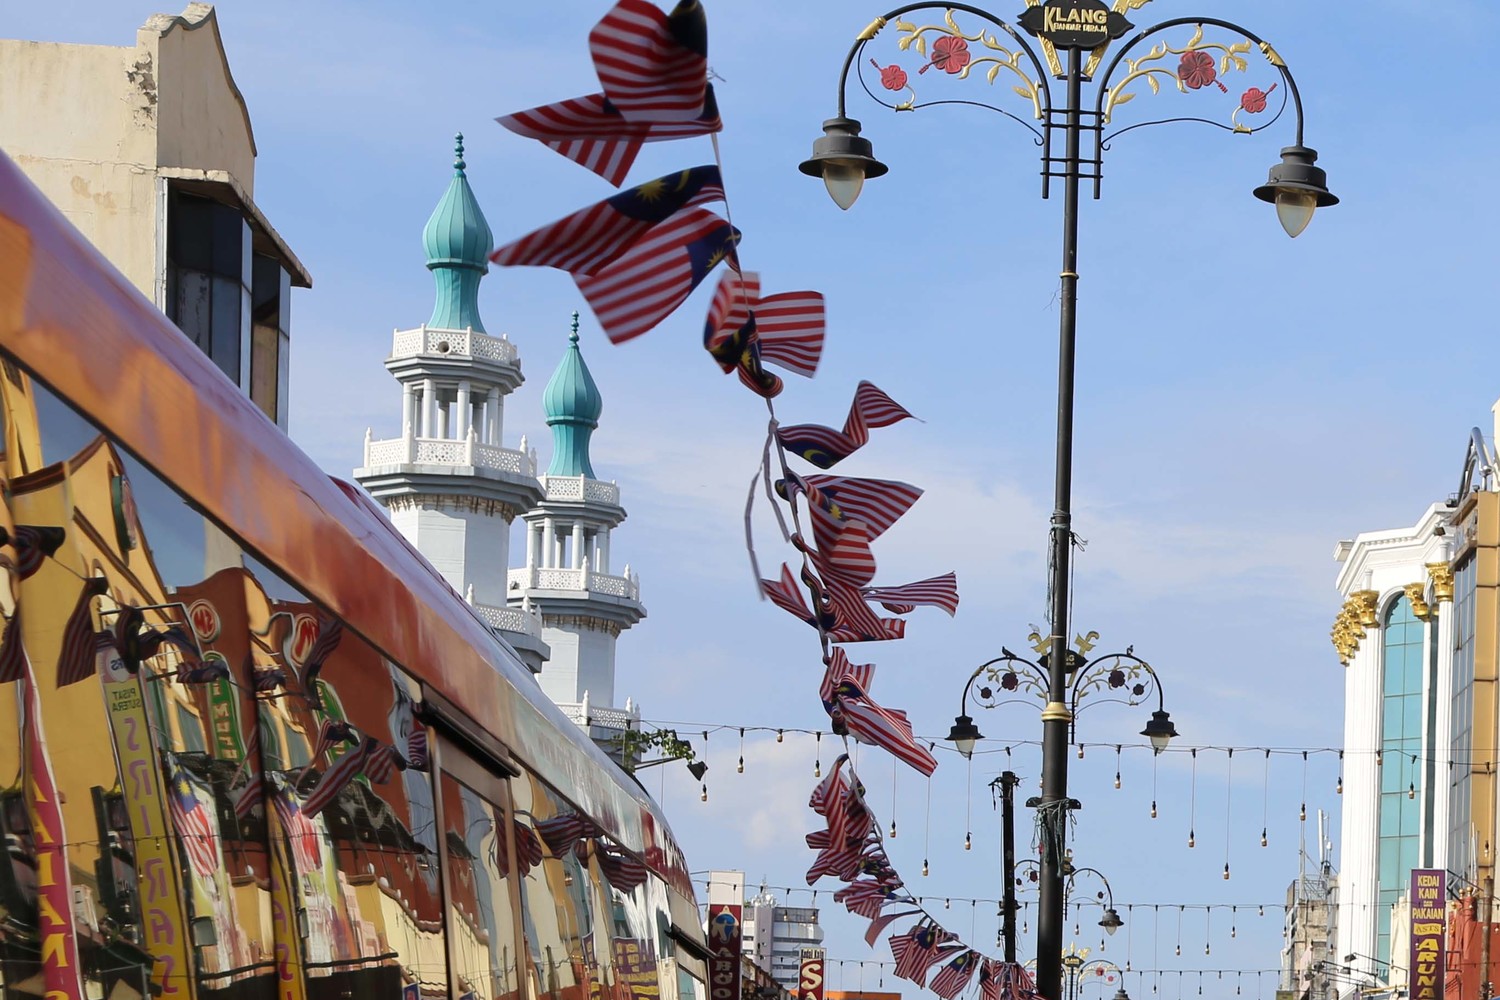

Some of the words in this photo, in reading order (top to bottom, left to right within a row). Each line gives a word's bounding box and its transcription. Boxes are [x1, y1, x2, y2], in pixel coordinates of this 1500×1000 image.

[1043, 6, 1107, 32] KLANG
[1417, 874, 1440, 888] KEDAI
[1418, 888, 1438, 900] KAIN
[1412, 907, 1444, 920] PAKAIAN
